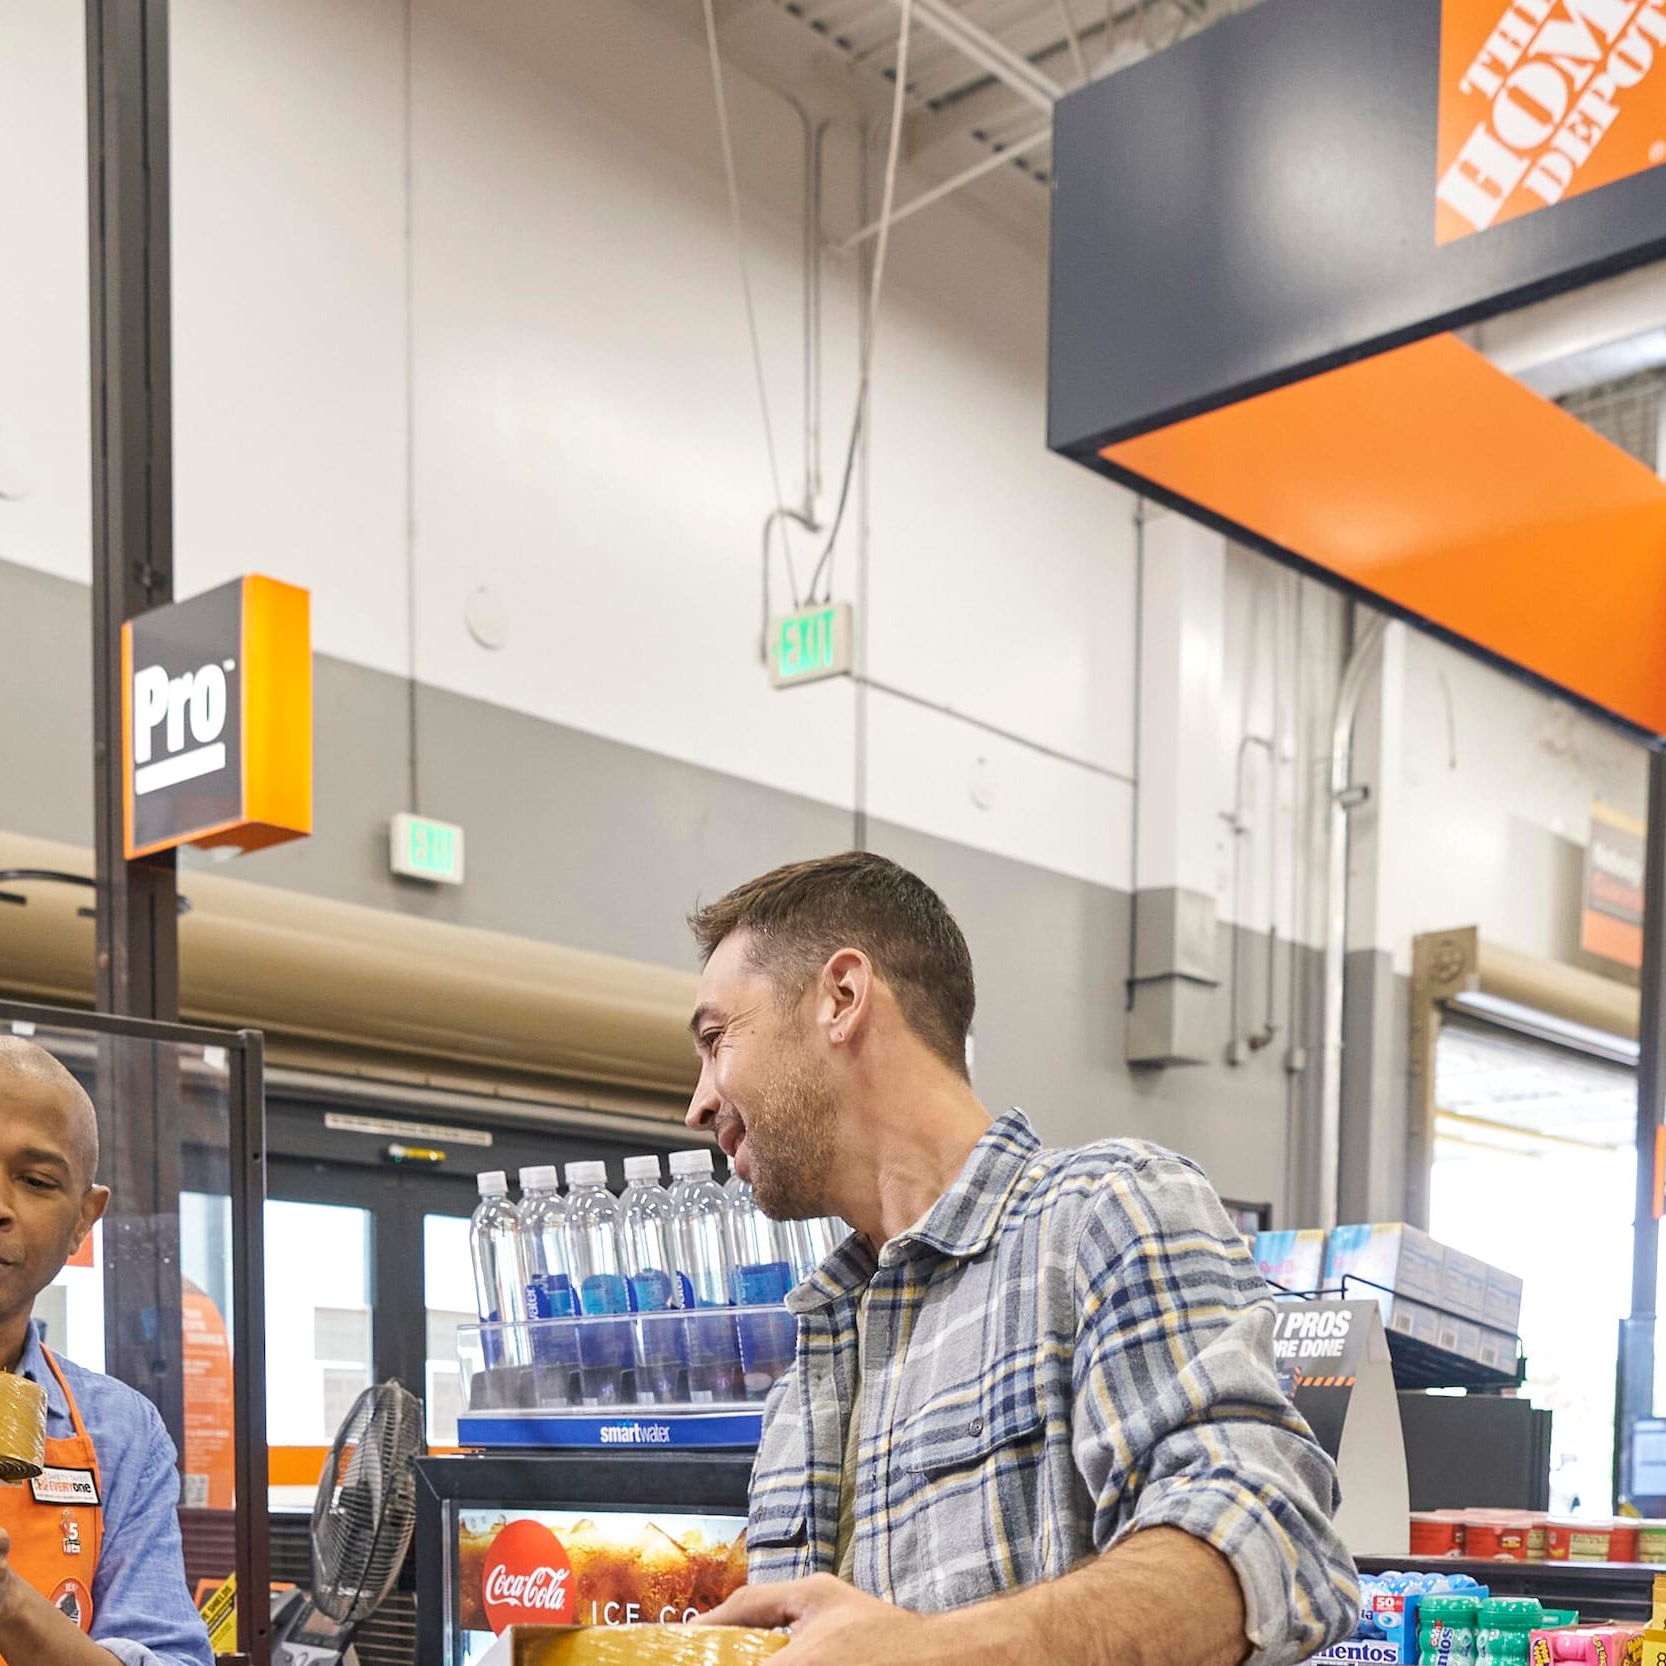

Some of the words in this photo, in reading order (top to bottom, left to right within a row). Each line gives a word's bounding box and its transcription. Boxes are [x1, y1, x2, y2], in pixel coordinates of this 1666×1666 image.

[1435, 0, 1643, 232] HOM
[778, 609, 836, 678] EXIT
[1285, 1309, 1353, 1338] PROS
[1299, 1338, 1345, 1358] DONE
[600, 1424, 671, 1444] smartwater
[485, 1564, 570, 1610] Coca-Cola
[591, 1600, 641, 1625] ICE
[1376, 1596, 1394, 1607] 50
